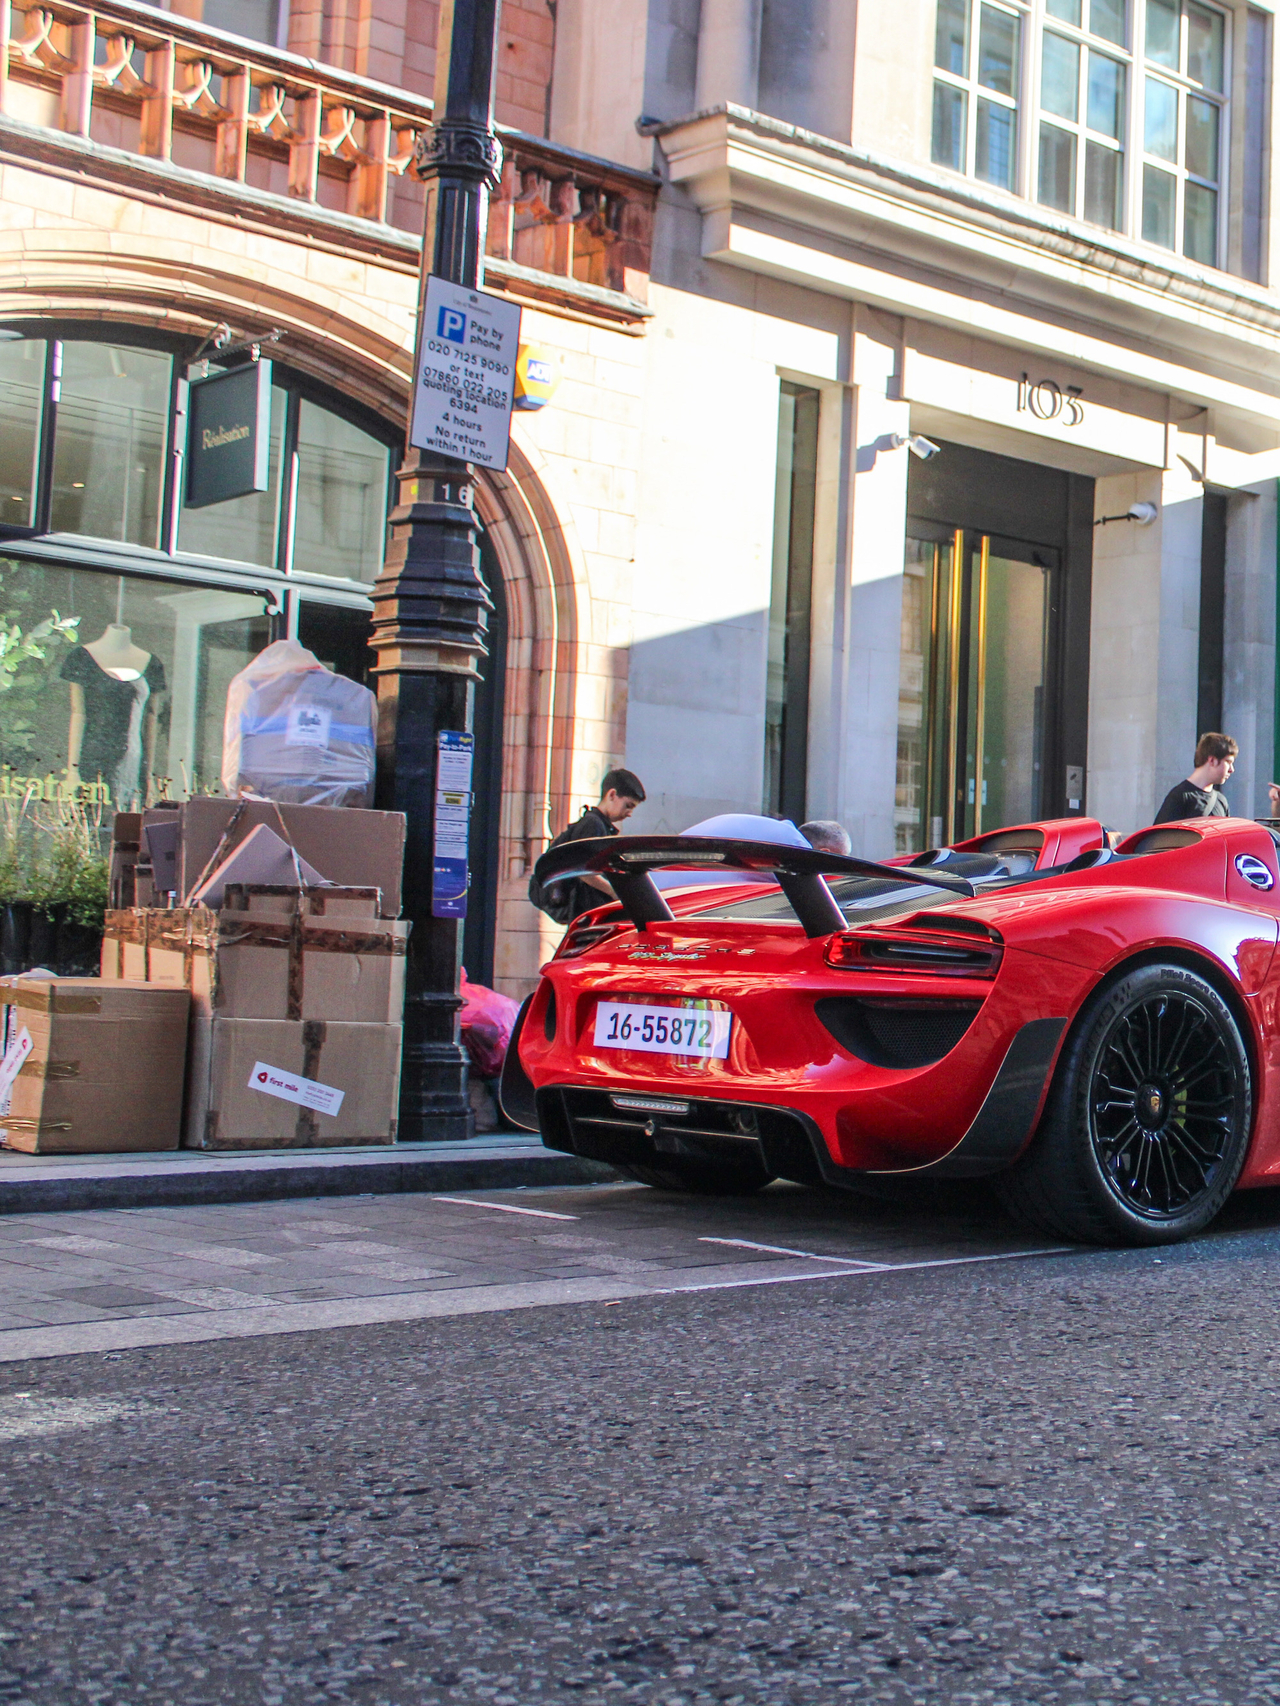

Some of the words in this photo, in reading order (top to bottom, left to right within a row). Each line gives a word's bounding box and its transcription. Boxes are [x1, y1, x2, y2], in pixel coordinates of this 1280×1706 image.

[443, 309, 463, 338] P
[471, 320, 488, 336] Pay
[492, 328, 504, 341] by
[470, 334, 502, 351] phone
[428, 340, 450, 356] 020
[454, 349, 477, 365] 7125
[481, 358, 510, 376] 9090
[423, 366, 459, 386] 07860
[463, 380, 484, 394] 022
[487, 386, 508, 401] 205
[450, 364, 461, 373] or
[464, 367, 485, 381] text
[423, 377, 463, 398] quoting
[465, 389, 507, 410] location
[450, 397, 478, 414] 6394
[1018, 371, 1084, 426] 103
[442, 411, 450, 422] 4
[453, 414, 483, 432] hours
[426, 436, 459, 453] within
[462, 445, 466, 455] 1
[469, 447, 493, 463] hour
[435, 425, 450, 438] No
[454, 431, 486, 448] return
[1160, 968, 1184, 981] Pilot
[1184, 973, 1210, 995] Sport
[607, 1012, 713, 1049] 16-55872
[269, 1076, 284, 1088] first
[284, 1082, 299, 1093] mile
